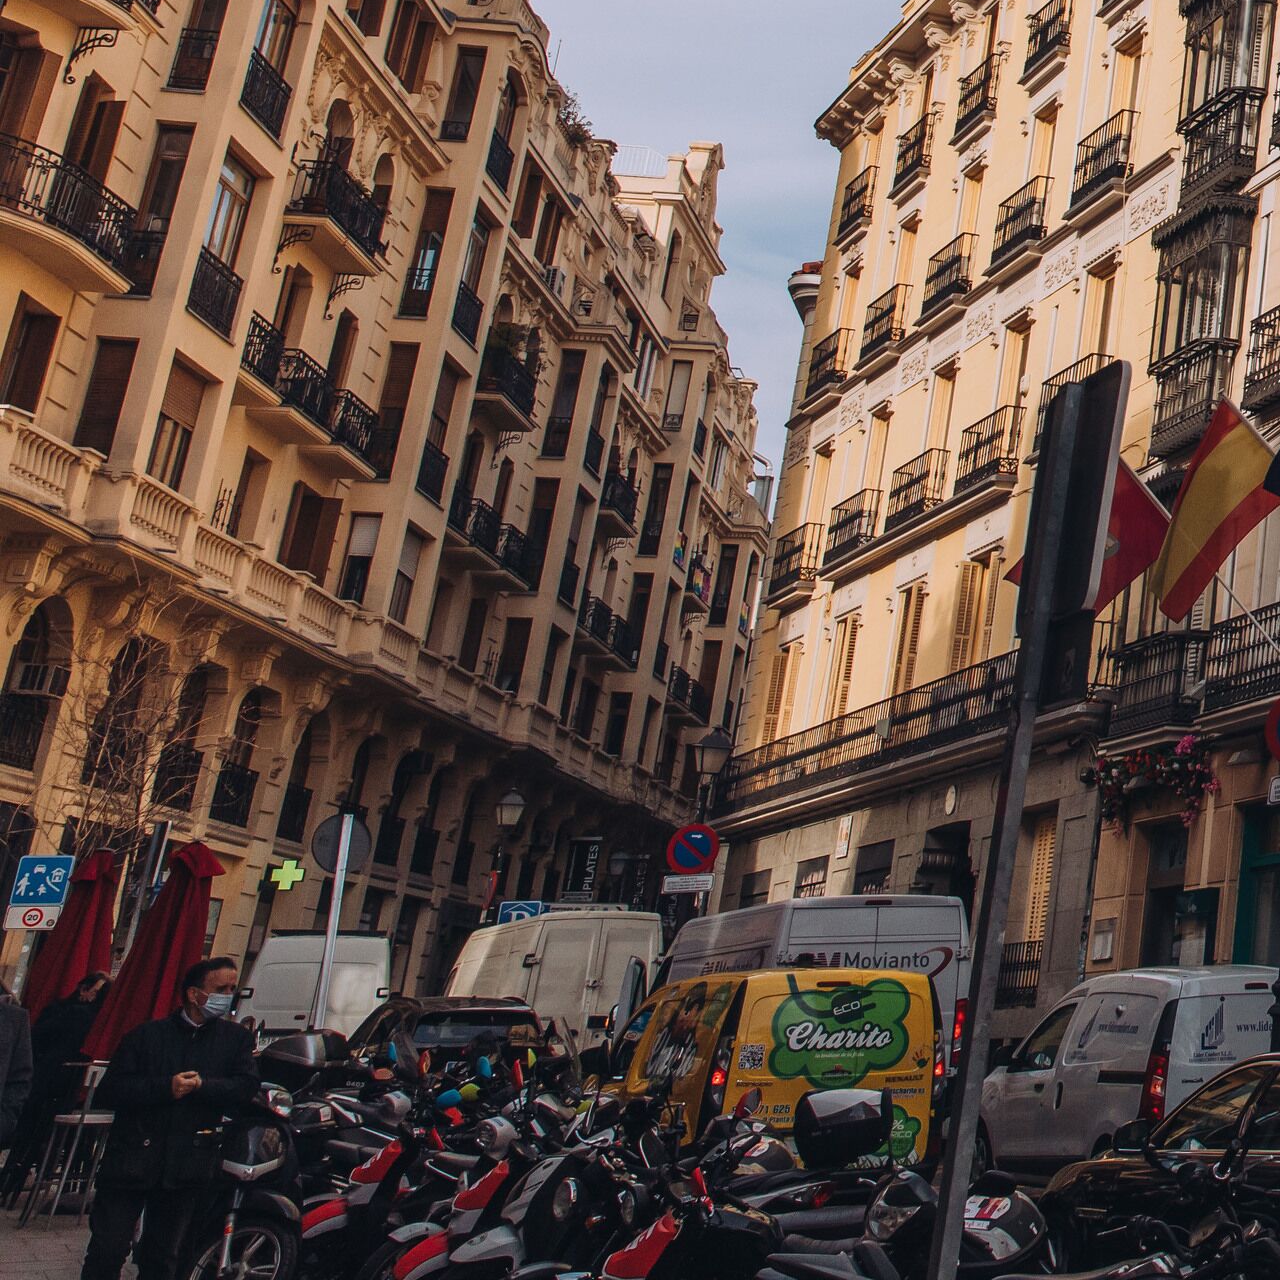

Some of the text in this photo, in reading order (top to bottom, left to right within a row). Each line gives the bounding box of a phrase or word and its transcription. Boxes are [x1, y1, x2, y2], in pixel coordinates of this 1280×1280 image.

[582, 844, 599, 891] PILATES
[843, 950, 930, 969] Movianto
[833, 1000, 861, 1016] ECO
[786, 1022, 893, 1051] Charito
